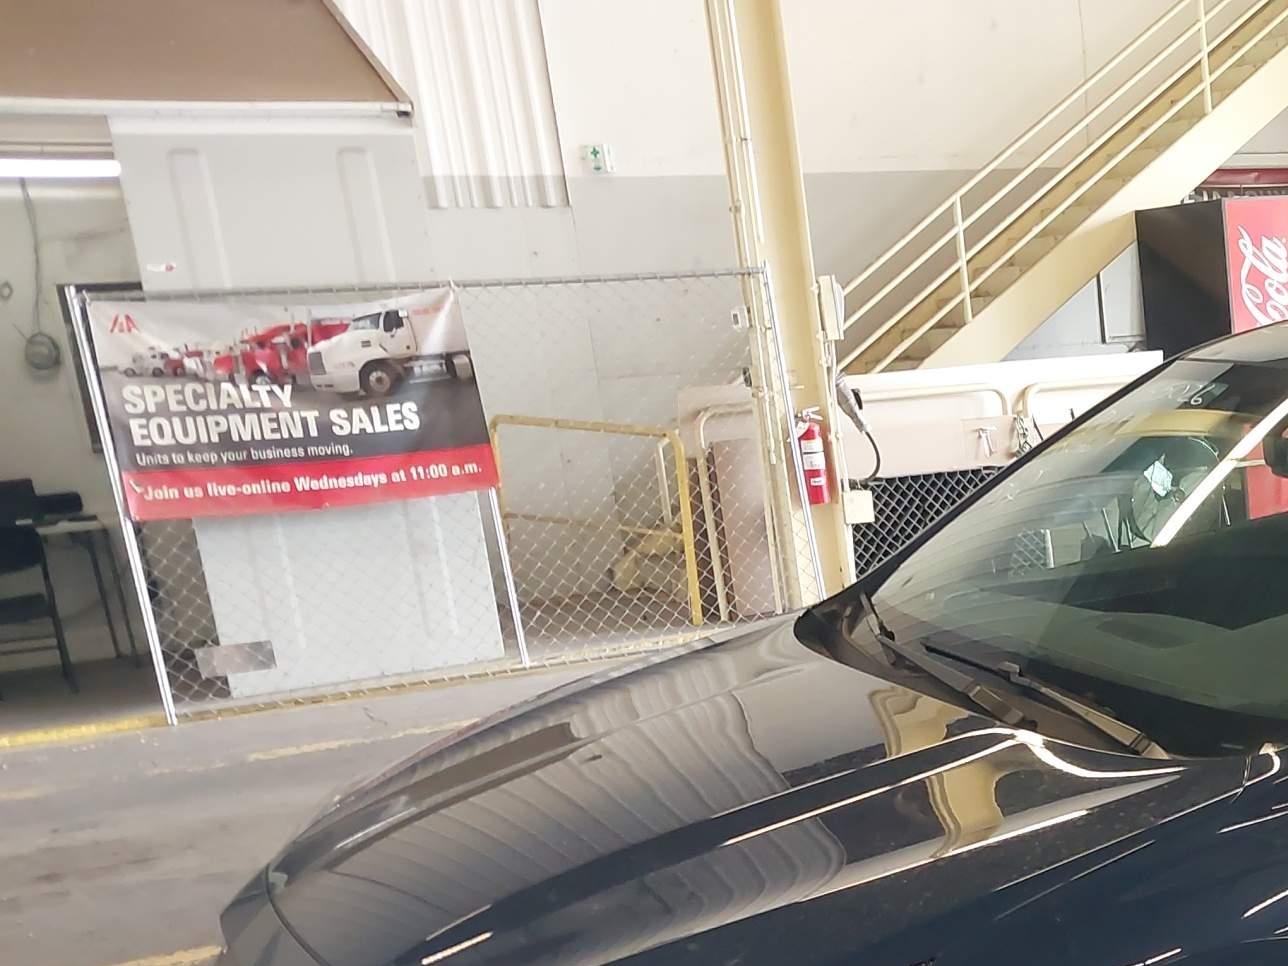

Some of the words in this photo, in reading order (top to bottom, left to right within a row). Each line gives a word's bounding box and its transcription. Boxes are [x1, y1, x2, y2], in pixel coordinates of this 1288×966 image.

[122, 382, 293, 413] SPECIALTY
[129, 410, 319, 446] EQUIPMENT
[330, 401, 420, 436] SALES
[136, 453, 169, 466] Units
[171, 453, 185, 464] to
[187, 451, 218, 464] keep
[221, 450, 248, 463] your
[251, 444, 304, 460] business
[307, 442, 353, 457] moving.
[143, 485, 179, 500] Join
[184, 486, 203, 498] us
[207, 479, 291, 496] live-online
[294, 473, 387, 492] Wednesdays
[391, 471, 406, 483] at
[410, 464, 448, 481] 11:00
[452, 462, 482, 476] a.m.
